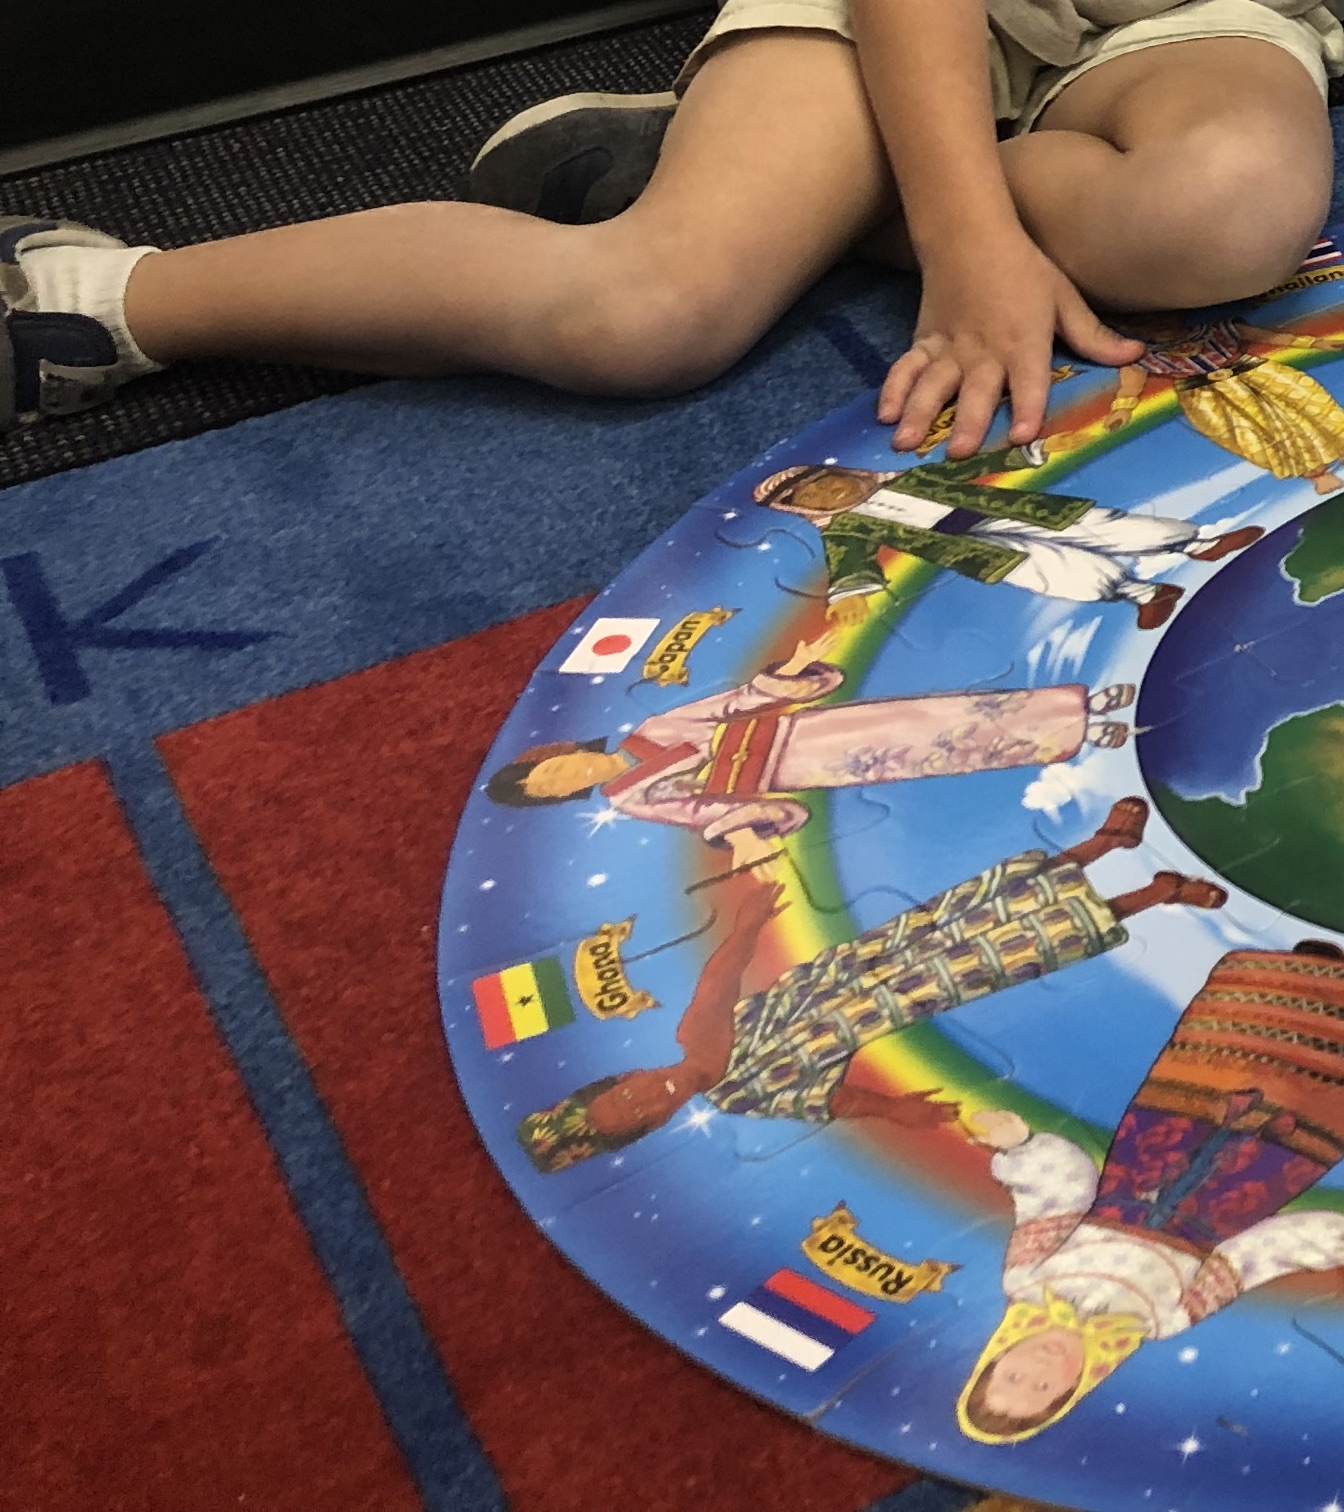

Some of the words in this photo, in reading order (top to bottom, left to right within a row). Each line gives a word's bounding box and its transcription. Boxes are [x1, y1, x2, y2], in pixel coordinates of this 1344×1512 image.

[2, 534, 283, 706] K
[647, 619, 702, 675] Japan
[589, 941, 631, 1012] Ghana
[816, 1233, 914, 1297] Russia
